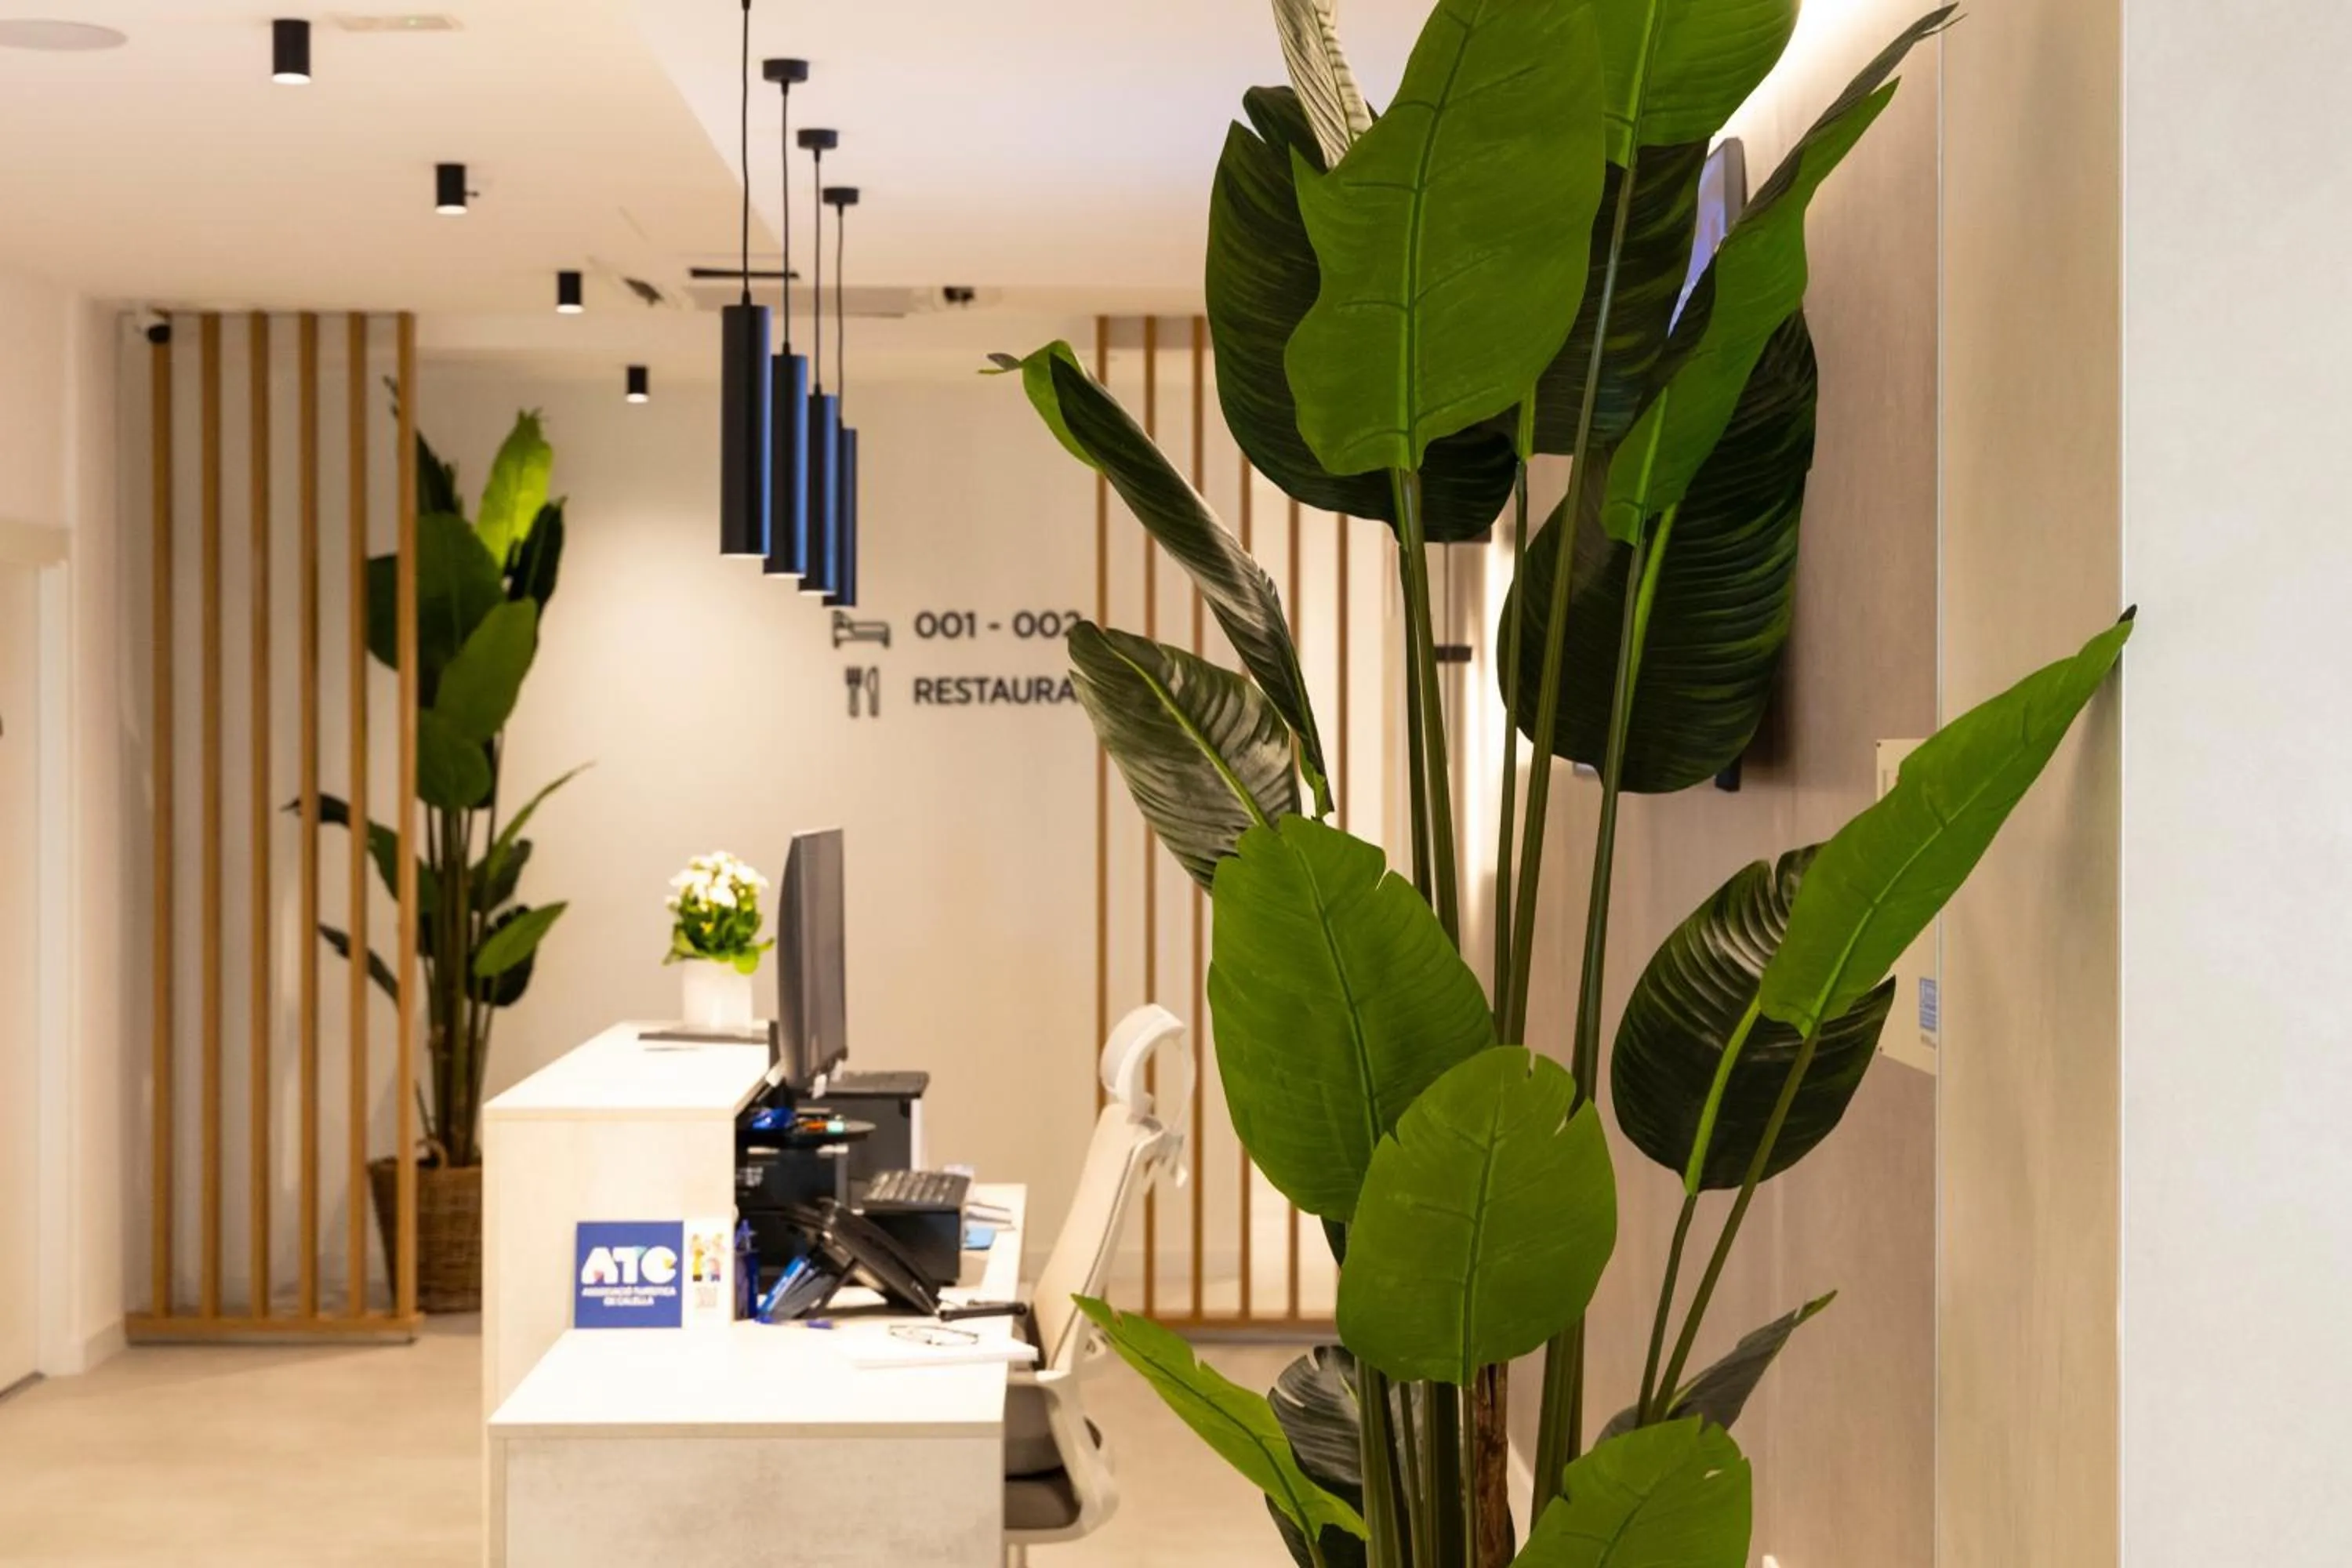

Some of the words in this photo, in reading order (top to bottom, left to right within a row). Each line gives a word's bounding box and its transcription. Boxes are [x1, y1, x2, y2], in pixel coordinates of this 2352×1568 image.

[914, 611, 976, 639] 001
[914, 677, 1077, 705] RESTAURA
[581, 1246, 677, 1284] ATC
